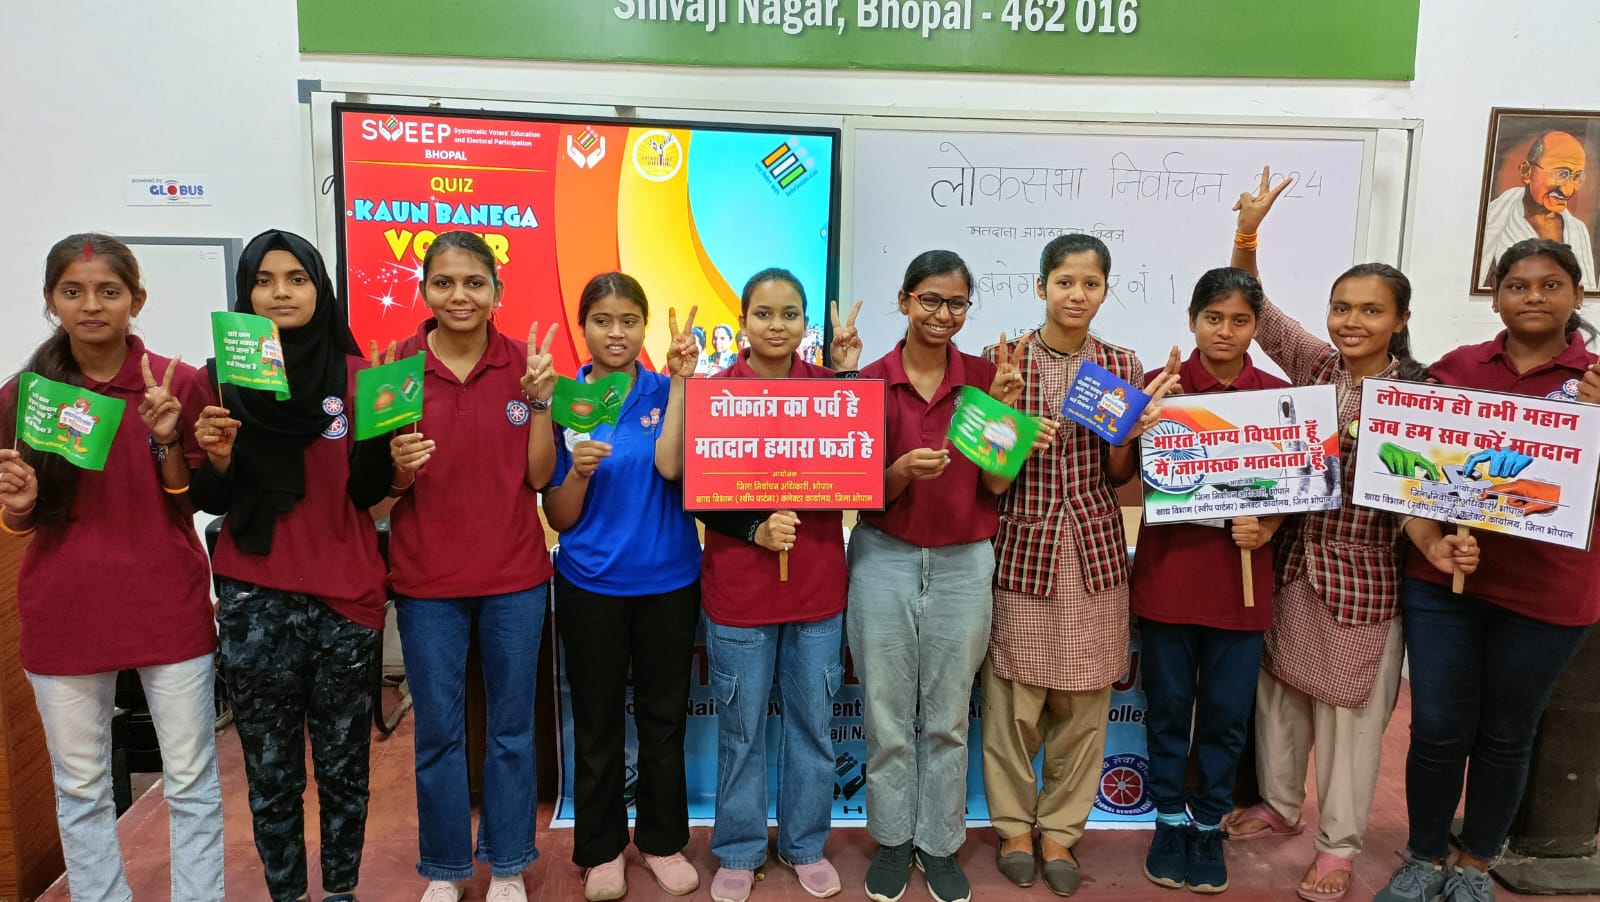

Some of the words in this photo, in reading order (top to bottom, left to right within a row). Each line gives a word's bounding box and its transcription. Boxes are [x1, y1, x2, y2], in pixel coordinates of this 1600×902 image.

[613, 0, 727, 32] Shivaji
[737, 0, 845, 35] Nagar,
[857, 0, 972, 37] Bhopal
[1000, 0, 1066, 32] 462
[1075, 0, 1138, 34] 016
[454, 127, 487, 136] Systematic
[510, 130, 541, 138] Education
[454, 136, 466, 144] and
[467, 137, 493, 145] Electoral
[494, 138, 532, 147] Participation
[425, 149, 467, 161] BHOPAL
[430, 176, 474, 193] QUIZ
[928, 141, 1088, 207] लोकसभा
[1108, 152, 1229, 203] निर्वाचन
[149, 183, 204, 197] GLOBUS
[354, 198, 429, 224] KAUN
[434, 202, 539, 229] BANEGA
[967, 225, 1017, 240] मतदाता
[383, 228, 511, 265] VOR
[710, 389, 778, 417] लोकतंत्र
[783, 396, 809, 417] का
[813, 389, 841, 417] पर्व
[842, 390, 860, 417] है
[1377, 386, 1444, 413] लोकतंत्र
[1451, 393, 1472, 417] हो
[1478, 401, 1518, 422] तभी
[1523, 408, 1580, 431] महान
[695, 437, 760, 459] मतदान
[764, 437, 815, 459] हमारा
[819, 431, 856, 459] फर्ज
[857, 431, 874, 459] है
[1153, 434, 1194, 450] भारत
[1199, 429, 1240, 446] भाग्य
[1244, 425, 1300, 444] विधाता
[1305, 419, 1319, 444] हूँ
[1368, 417, 1401, 437] जब
[1405, 422, 1434, 441] हम
[1438, 428, 1470, 447] सब
[1474, 429, 1507, 452] करें
[1509, 438, 1583, 465] मतदान
[1154, 457, 1171, 477] मैं
[1174, 456, 1239, 476] जागरूक
[1243, 452, 1306, 471] मतदाता
[1310, 445, 1325, 471] हूँ
[736, 480, 752, 490] जिला
[754, 480, 779, 491] निर्वाचन
[812, 480, 832, 490] भोपाल
[1194, 492, 1210, 501] जिला
[835, 492, 851, 502] जिला
[852, 492, 873, 502] भोपाल
[1293, 496, 1308, 505] जिला
[1311, 494, 1331, 504] भोपाल
[1382, 493, 1405, 506] विभाग
[1525, 520, 1545, 534] जिला
[1547, 525, 1574, 539] भोपाल
[1499, 504, 1525, 517] भोपाल
